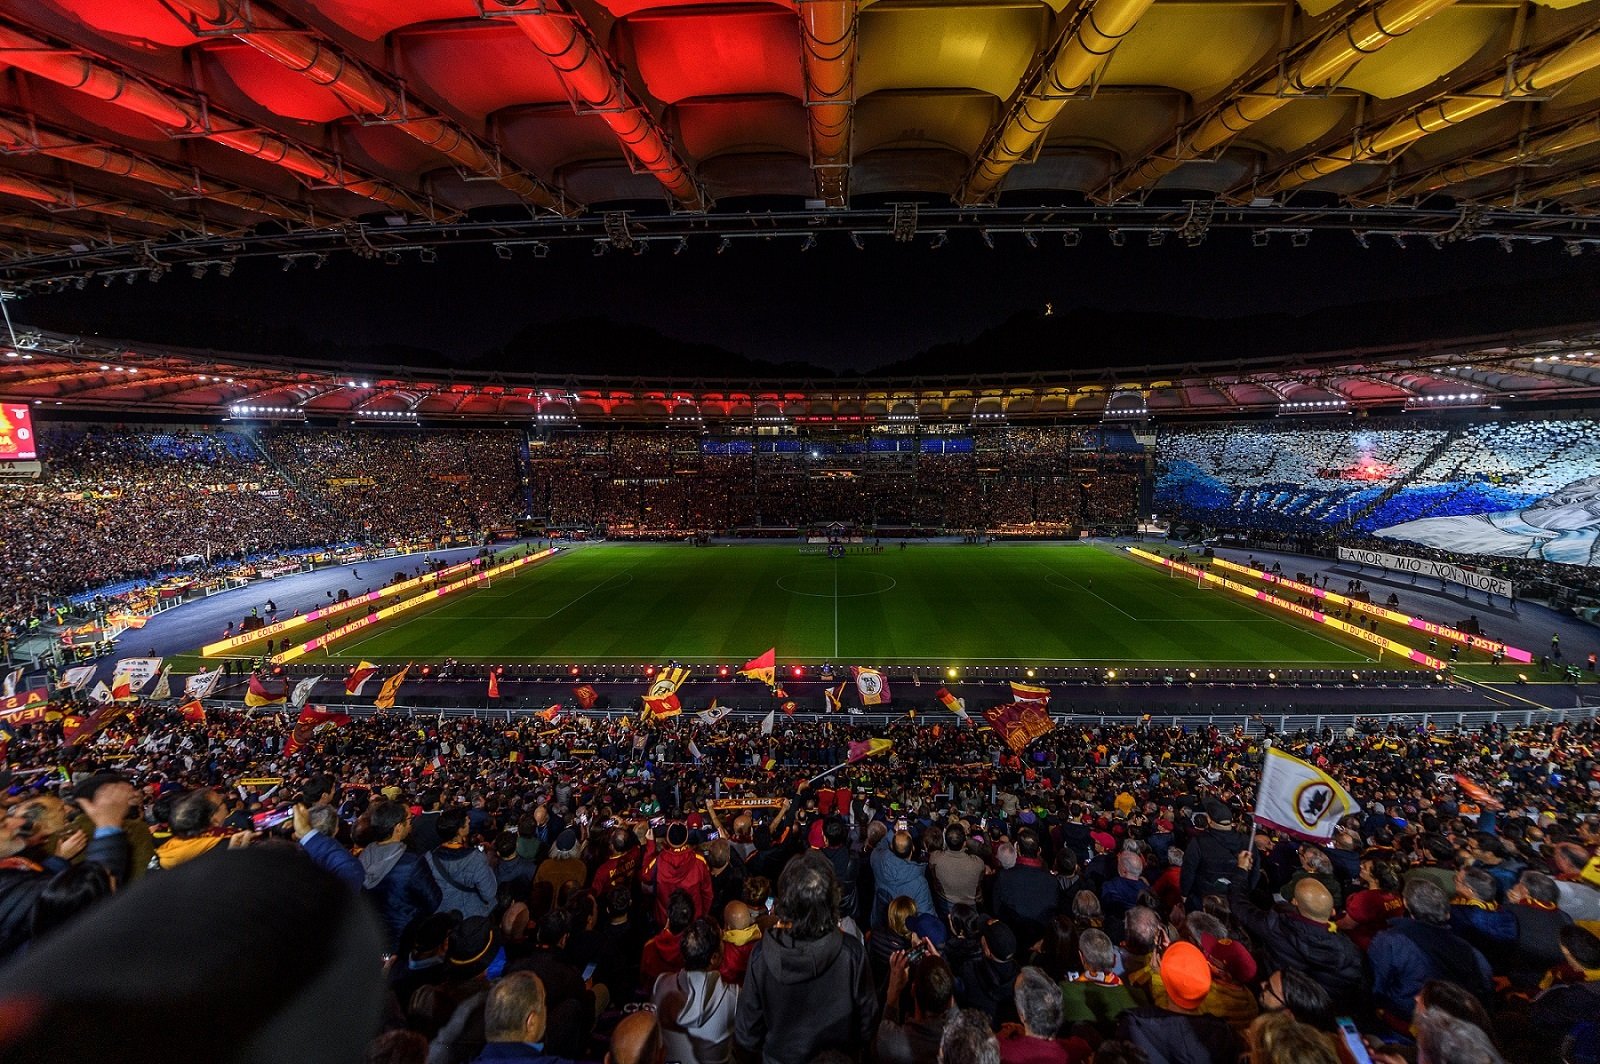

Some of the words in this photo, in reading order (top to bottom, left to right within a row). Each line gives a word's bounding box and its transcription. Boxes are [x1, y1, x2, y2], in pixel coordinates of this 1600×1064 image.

[1394, 557, 1421, 571] MIO
[1430, 561, 1457, 582] NON
[1461, 572, 1507, 596] MUORE
[318, 608, 327, 618] DE
[328, 603, 347, 615] ROMA
[347, 595, 370, 609] NOSTRA
[1362, 603, 1389, 617] COLORI
[231, 638, 239, 647] LI
[241, 631, 256, 644] DU'
[257, 622, 286, 638] COLORI
[317, 635, 326, 646] DE
[326, 628, 346, 643] ROMA
[346, 616, 370, 633] NOSTRA
[1342, 622, 1349, 631] LI
[1349, 625, 1362, 636] DU'
[1363, 631, 1390, 647] COLORI
[1425, 623, 1438, 634] DE
[1438, 626, 1466, 643] ROMA
[1425, 656, 1439, 668] DE
